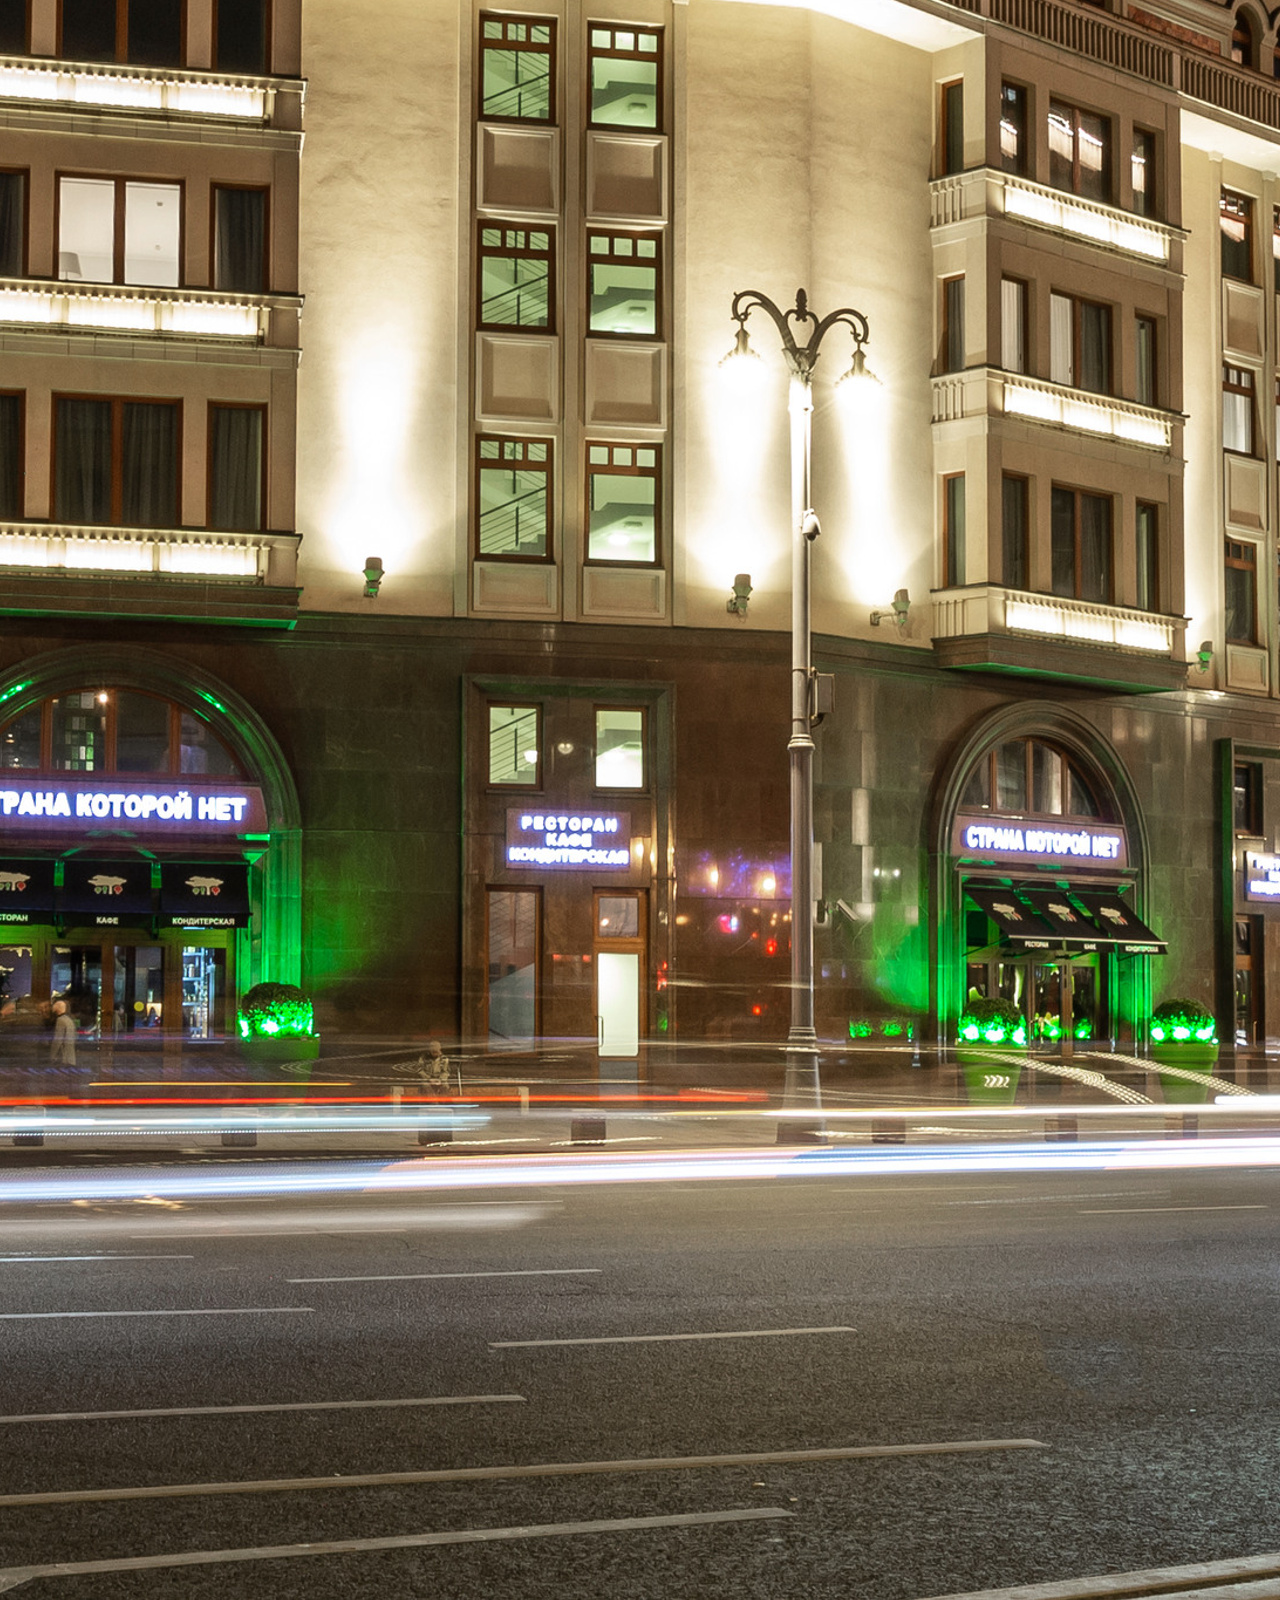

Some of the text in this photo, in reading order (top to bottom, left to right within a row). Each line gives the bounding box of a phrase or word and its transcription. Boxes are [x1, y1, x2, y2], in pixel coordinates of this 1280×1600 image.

[0, 791, 247, 821] РАНА КОТОРОЙ НЕТ
[521, 815, 618, 832] РЕСТОРАН
[546, 832, 592, 848] КАФЕ
[967, 825, 1120, 858] СТРАНА КОТОРОЙ НЕТ
[0, 913, 29, 922] ТОРАН
[96, 916, 119, 925] КАФЕ
[172, 917, 235, 926] КОНДИТЕРСКАЯ
